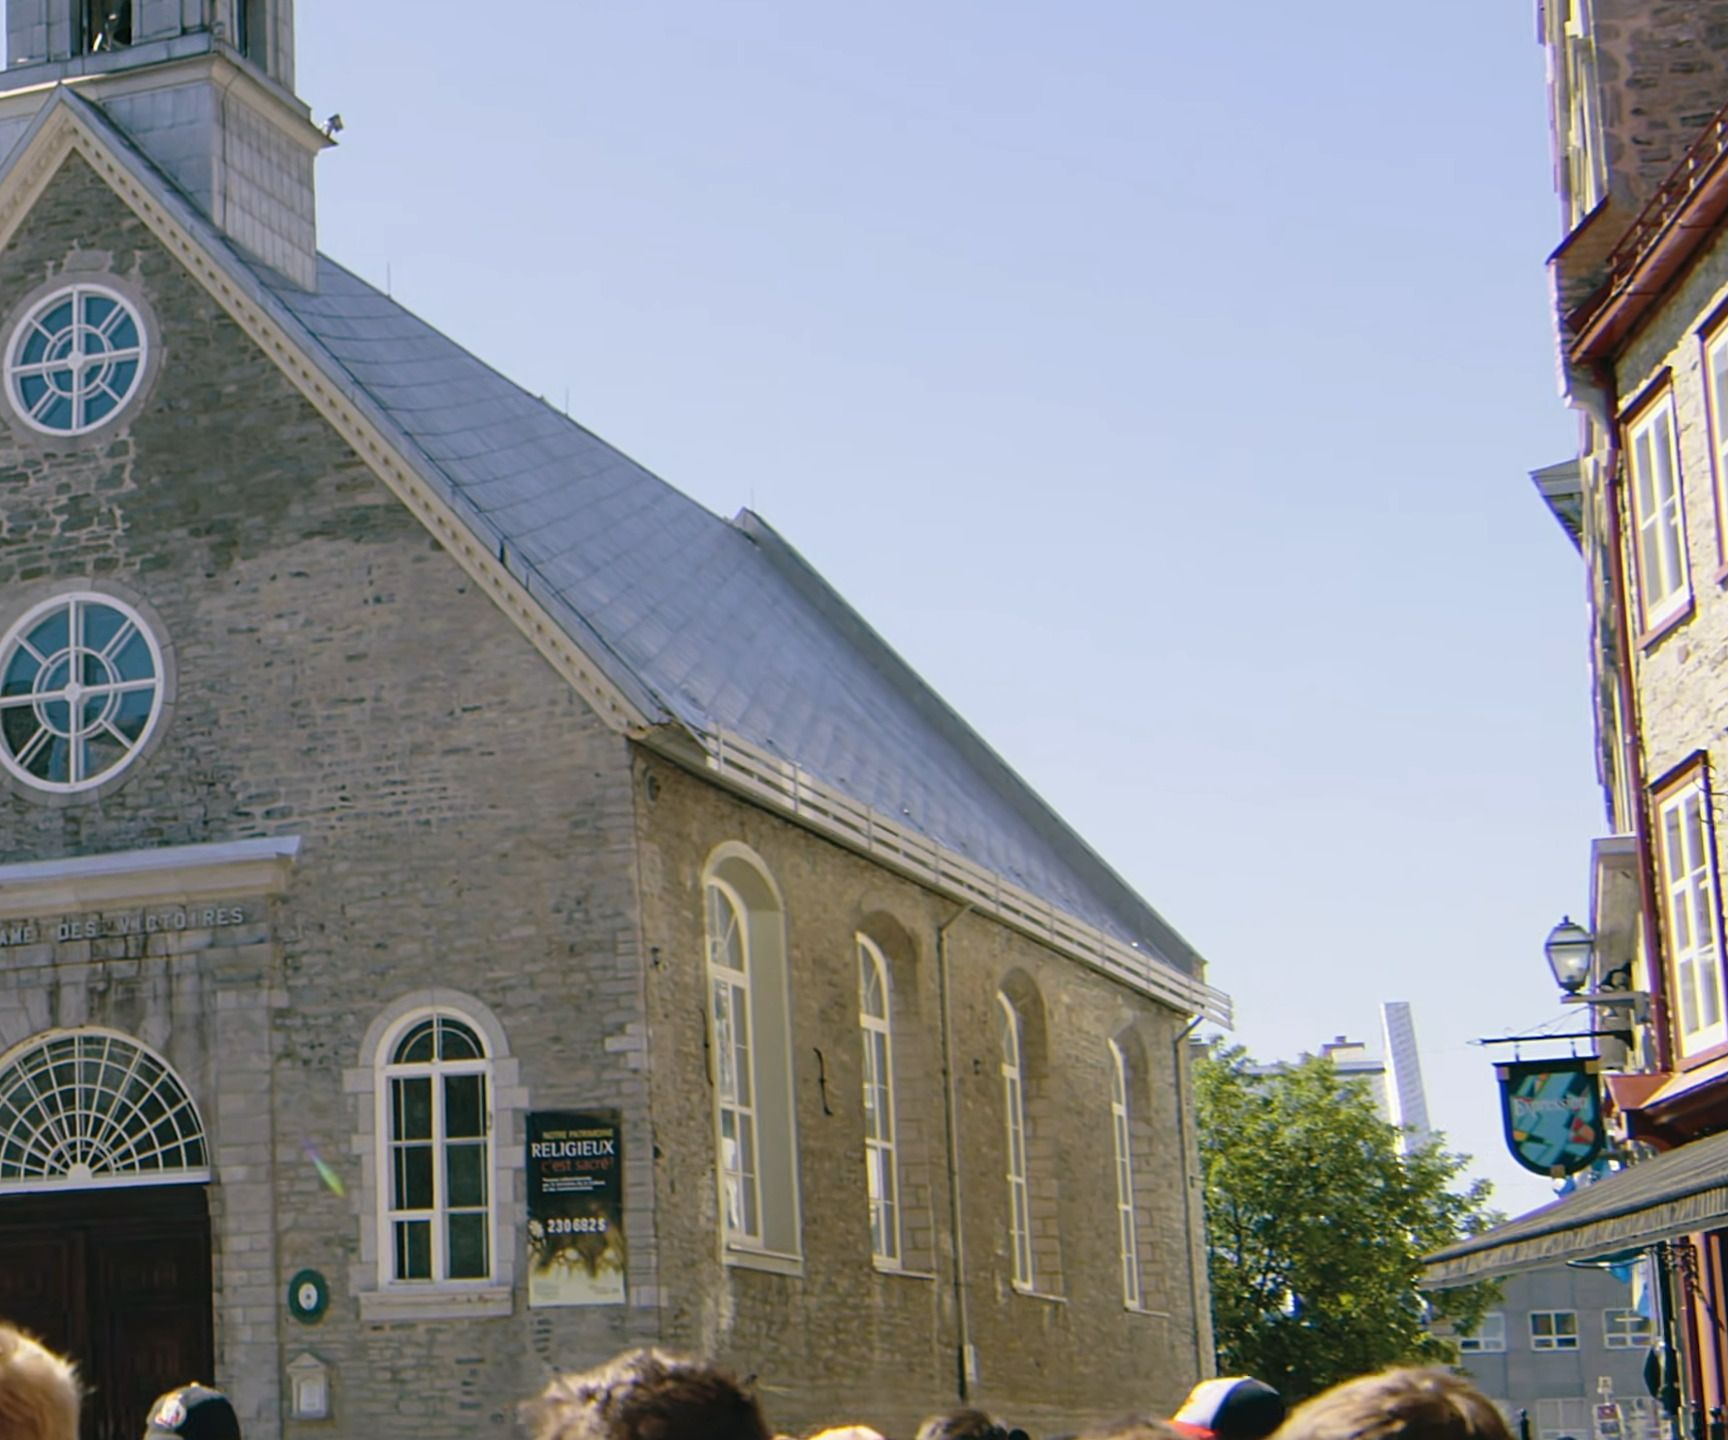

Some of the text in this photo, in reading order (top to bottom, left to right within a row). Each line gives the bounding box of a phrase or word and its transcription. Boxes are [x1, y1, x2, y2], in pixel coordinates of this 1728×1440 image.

[57, 921, 97, 941] DES
[119, 907, 244, 934] VICTOIRES
[530, 1139, 615, 1158] RELIGIEUX
